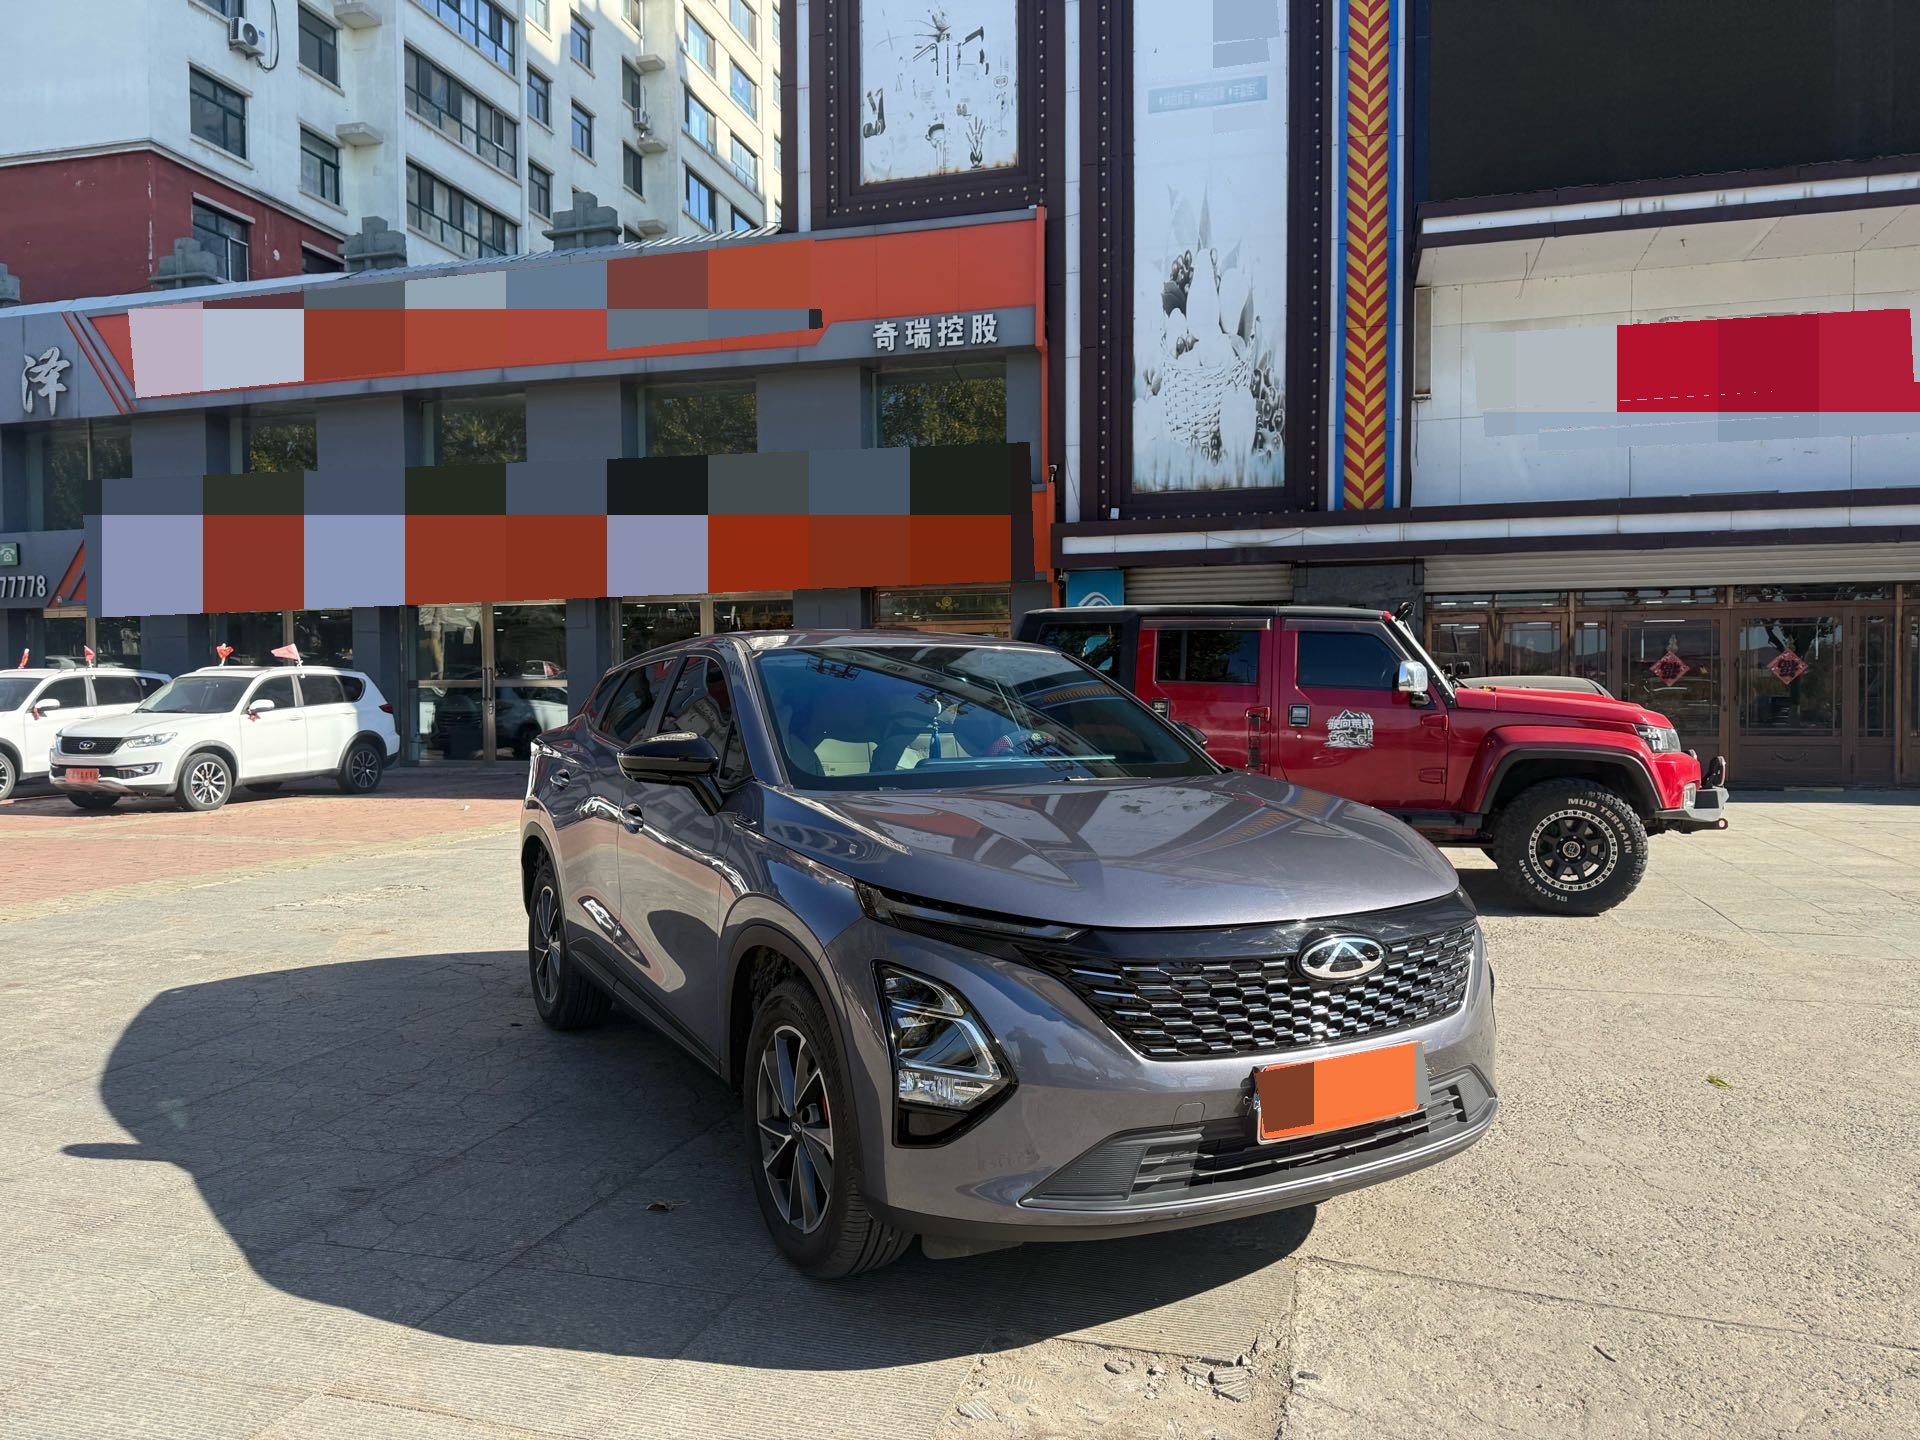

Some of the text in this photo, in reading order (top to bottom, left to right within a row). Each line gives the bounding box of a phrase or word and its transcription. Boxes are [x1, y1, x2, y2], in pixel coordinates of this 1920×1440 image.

[873, 313, 998, 351] 奇瑞控股
[22, 347, 70, 416] 泽
[0, 575, 46, 598] 77778
[1567, 798, 1633, 854] MUD TERRAIN
[1518, 859, 1568, 902] BLACK BEAR
